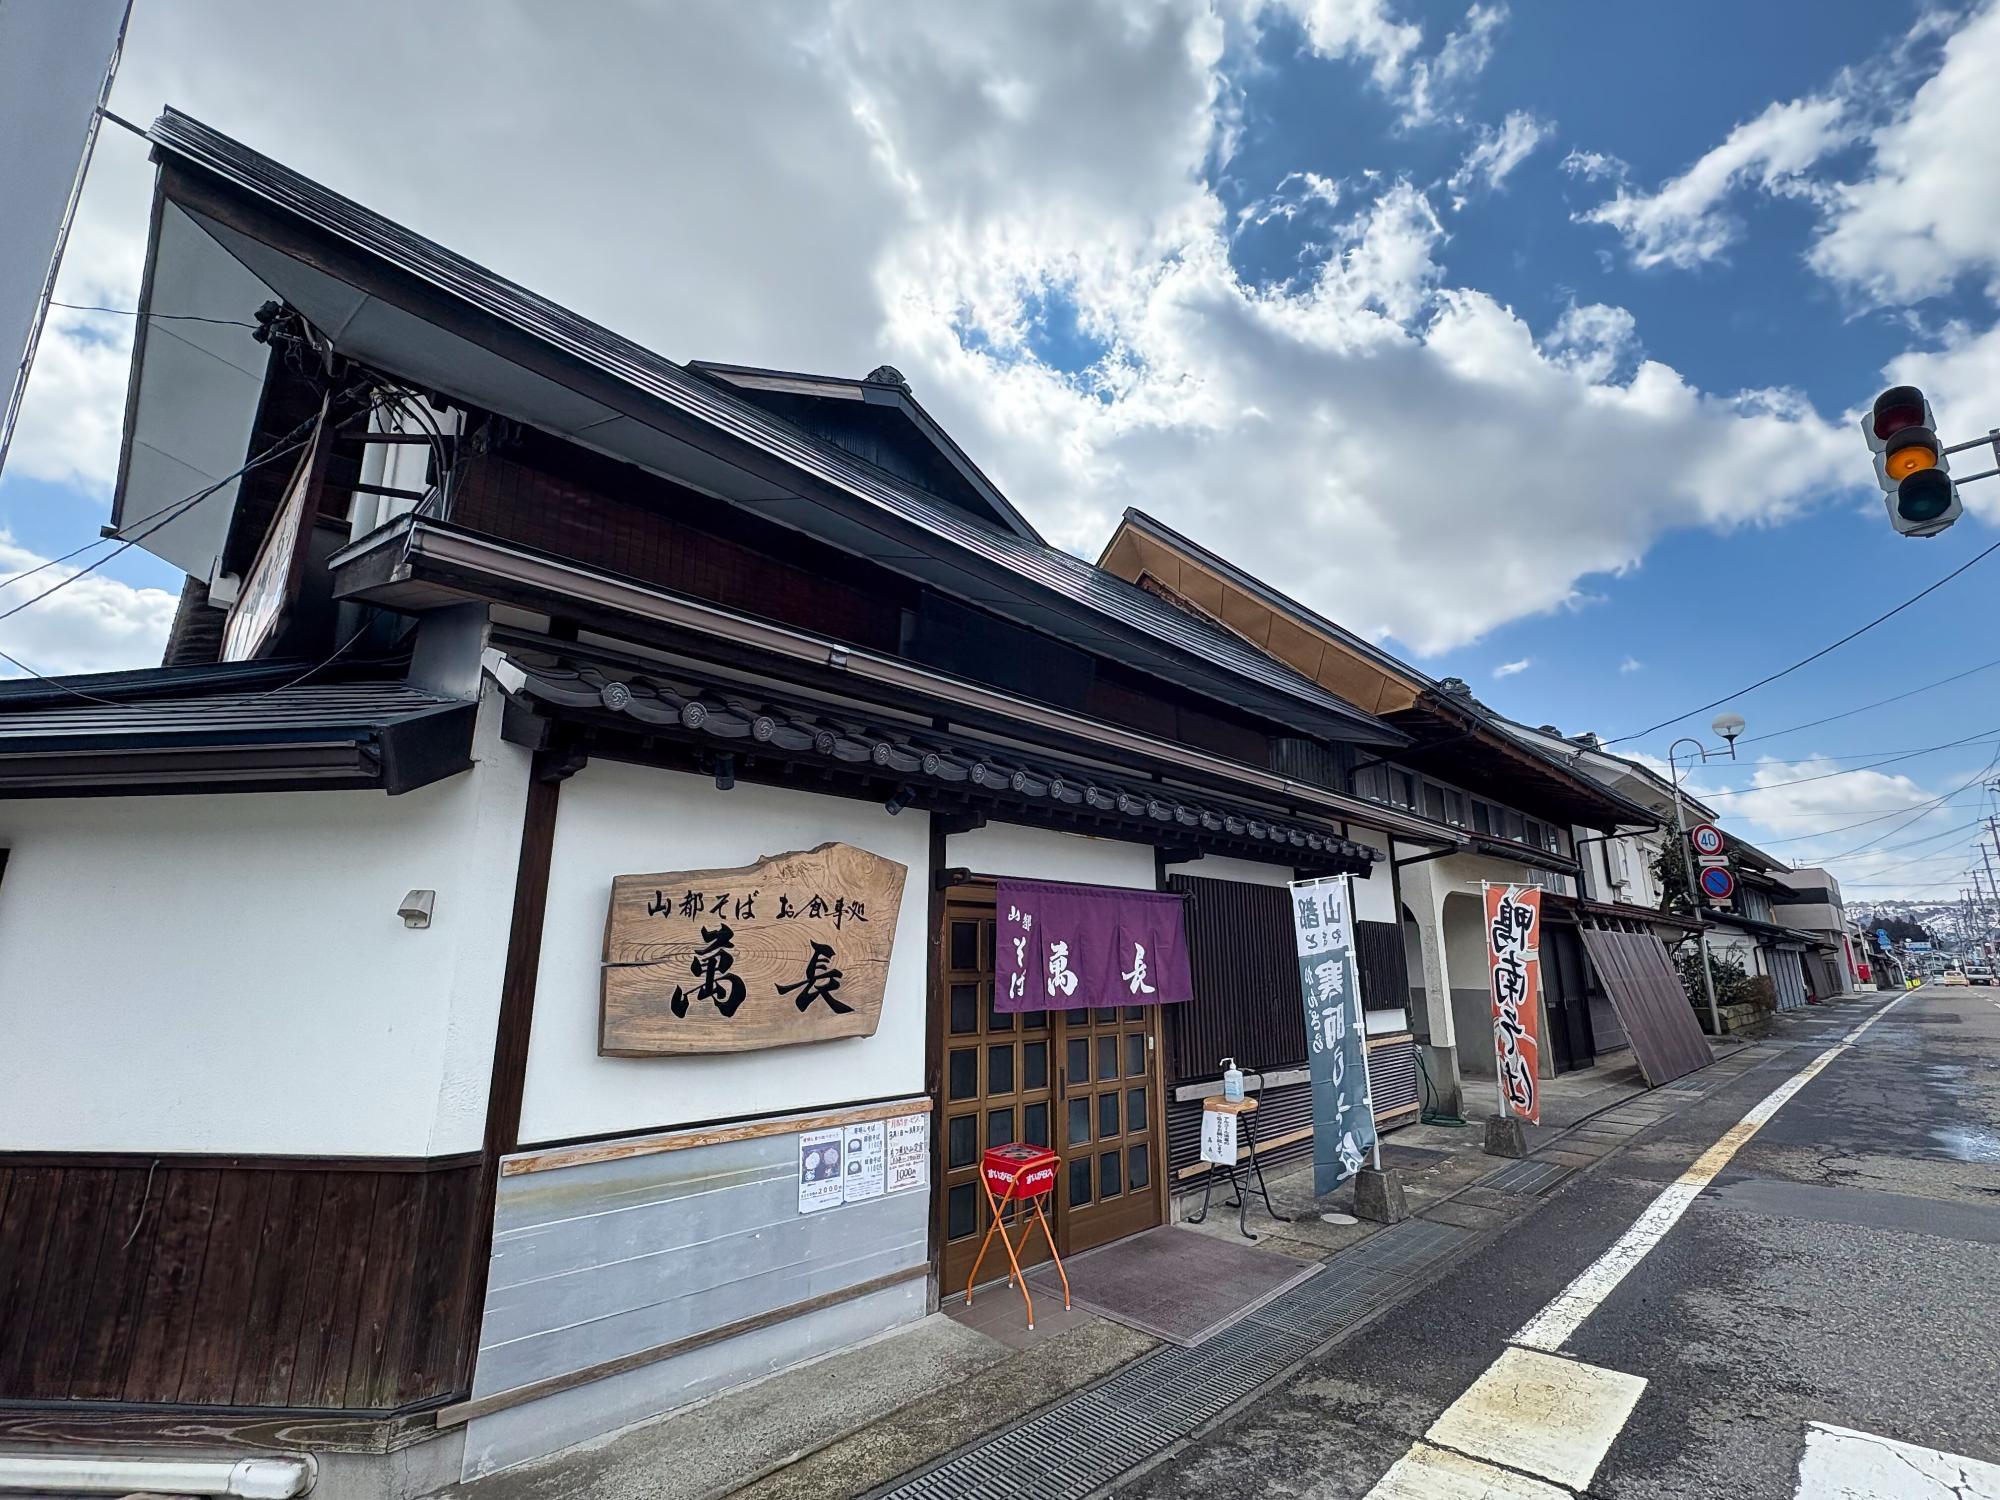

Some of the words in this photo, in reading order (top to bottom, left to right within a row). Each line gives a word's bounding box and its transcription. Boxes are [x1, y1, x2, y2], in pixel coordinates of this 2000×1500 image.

[1700, 833, 1716, 846] 40
[648, 889, 759, 922] 山都そば
[775, 892, 869, 930] お食事処
[670, 923, 855, 1018] 萬長
[1047, 940, 1156, 997] 萬長
